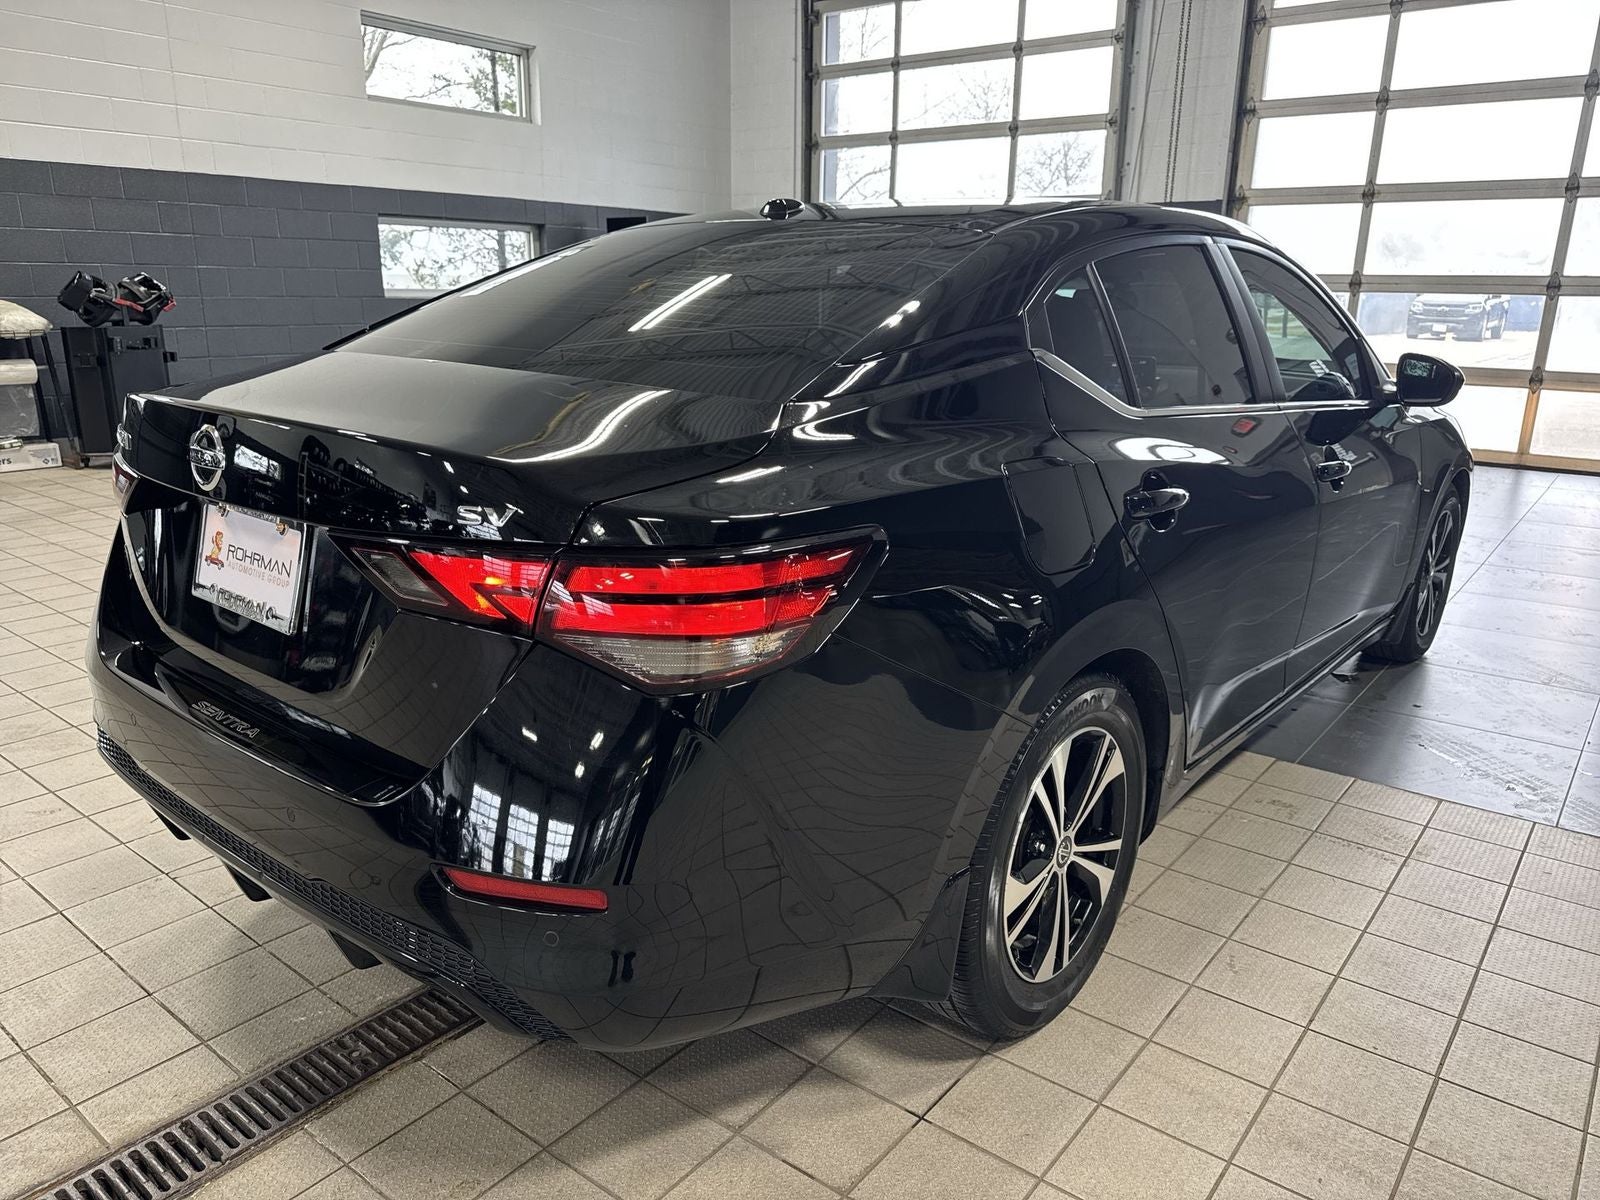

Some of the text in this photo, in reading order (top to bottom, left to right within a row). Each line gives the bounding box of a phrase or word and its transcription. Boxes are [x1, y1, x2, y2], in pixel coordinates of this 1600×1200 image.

[0, 457, 12, 465] rs
[457, 505, 517, 527] SV
[226, 544, 292, 578] ROHRMAN
[228, 561, 290, 588] AUTOMOTIVE GROUP
[192, 701, 260, 738] SENTRA
